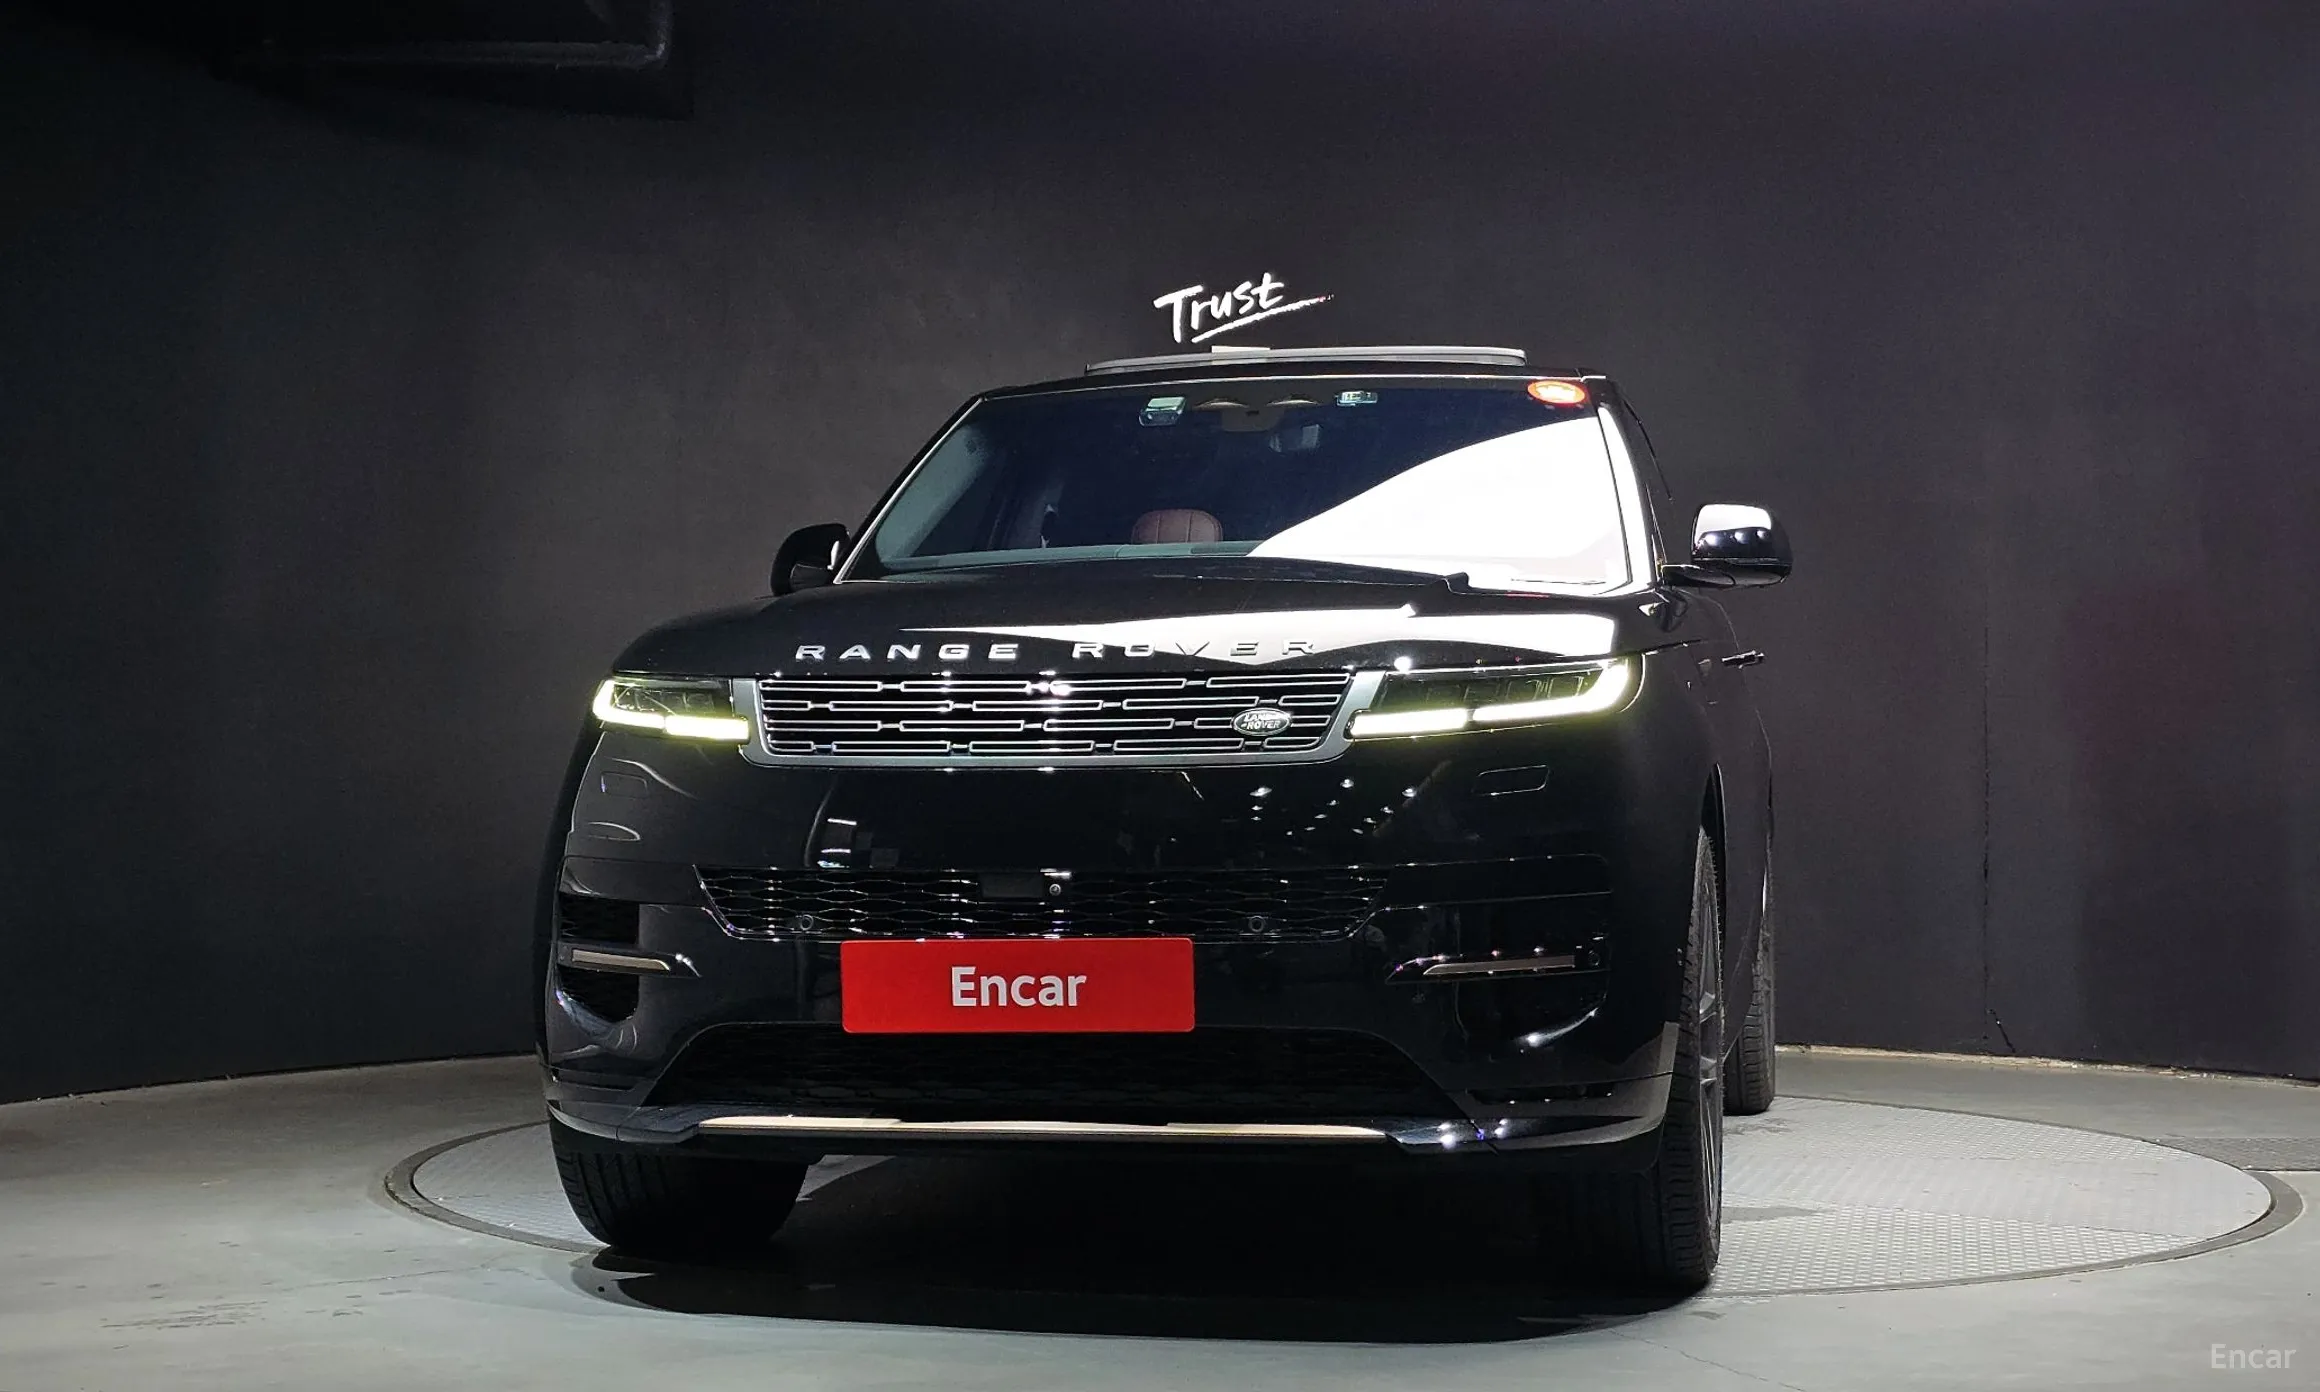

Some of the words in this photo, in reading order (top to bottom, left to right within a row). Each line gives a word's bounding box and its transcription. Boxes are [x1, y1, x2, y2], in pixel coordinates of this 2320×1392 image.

[1153, 272, 1285, 344] Trust
[795, 643, 1019, 660] RANGE
[1071, 640, 1315, 659] ROVER
[951, 966, 1087, 1007] Encar
